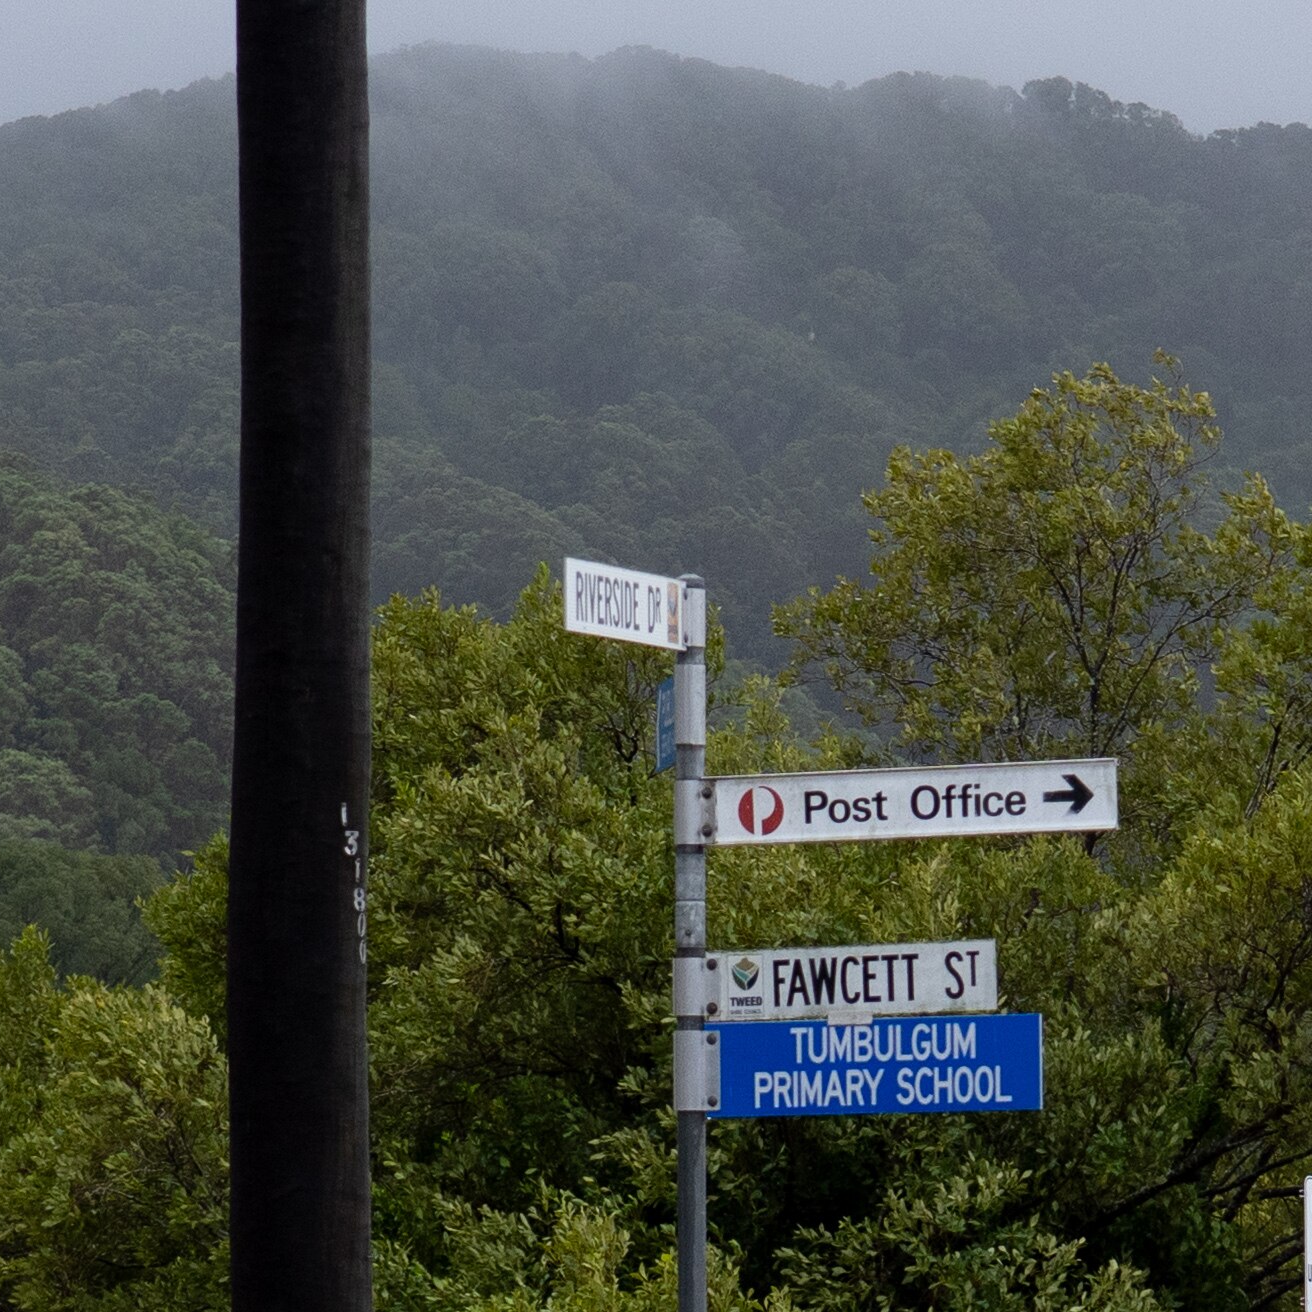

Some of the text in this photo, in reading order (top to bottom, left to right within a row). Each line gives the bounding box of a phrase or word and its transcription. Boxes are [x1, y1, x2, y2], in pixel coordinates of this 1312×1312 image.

[575, 570, 662, 634] RIVERSIDE DR
[804, 783, 1027, 824] Post Office
[773, 951, 980, 1008] FAWCETT ST
[729, 996, 763, 1007] TWEED
[790, 1022, 978, 1064] TUMBULGUM
[754, 1065, 1013, 1109] PRIMARY SCHOOL
